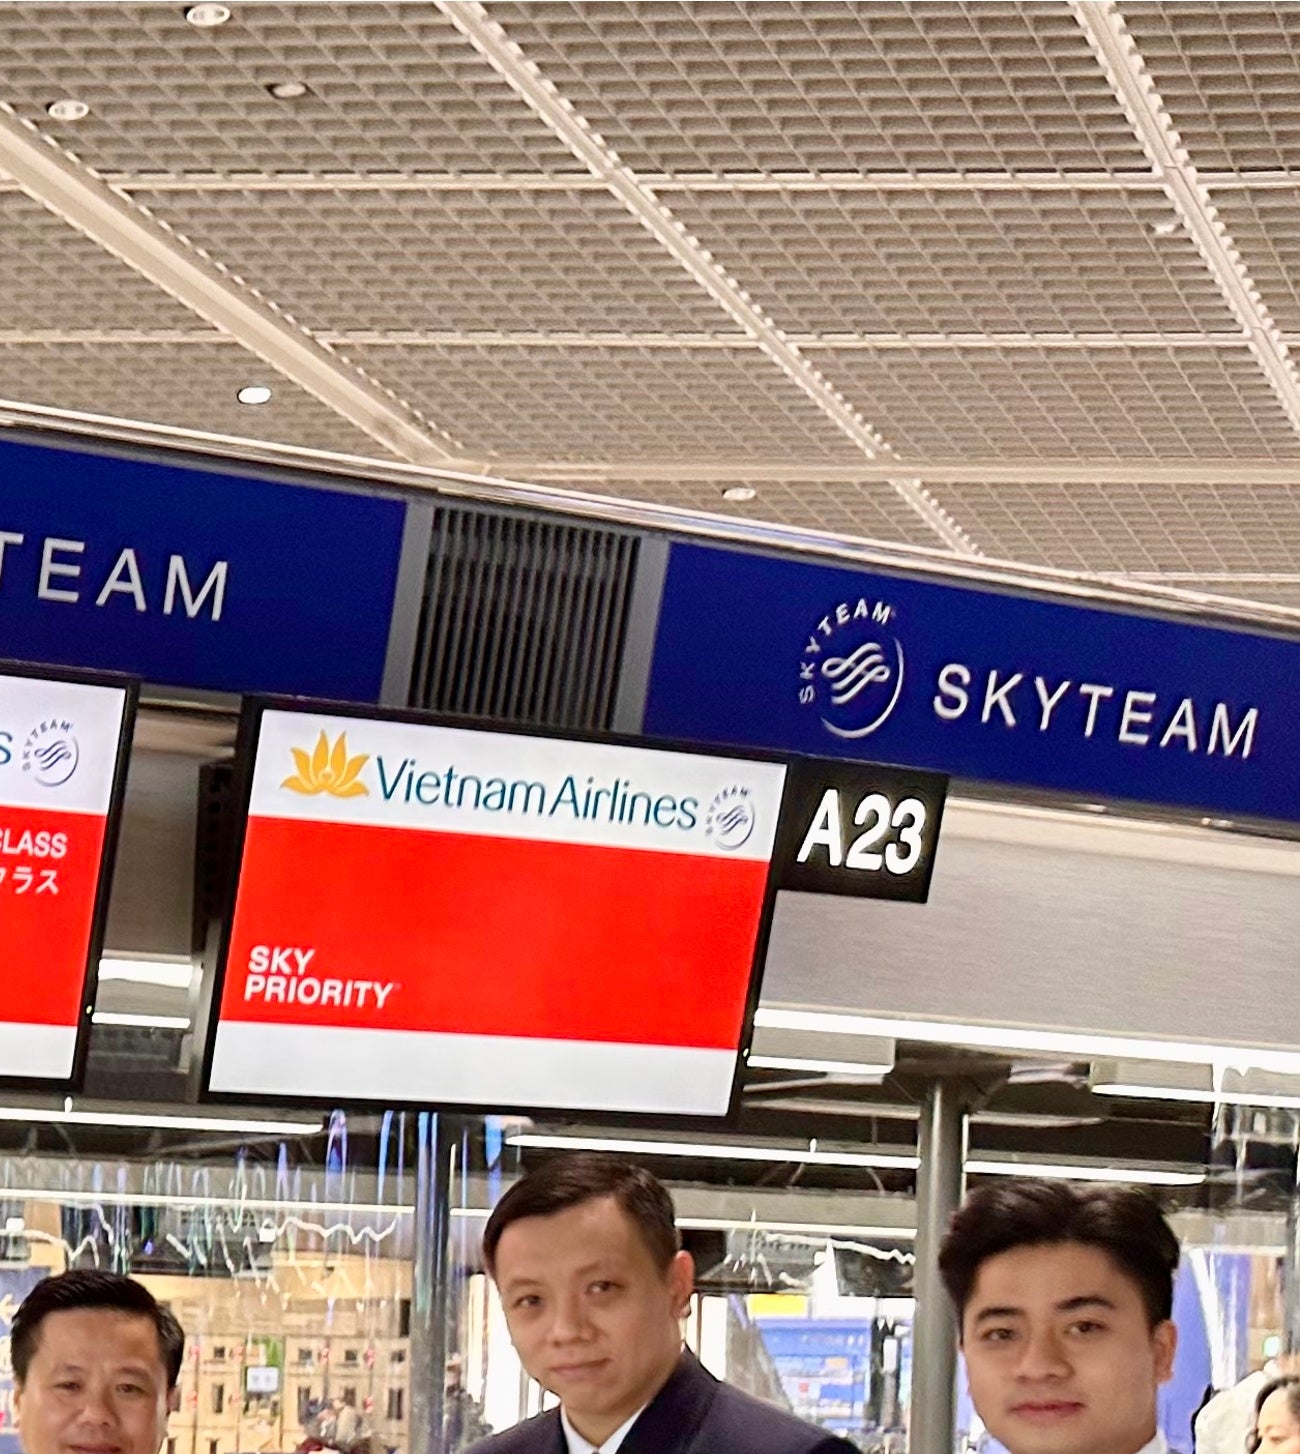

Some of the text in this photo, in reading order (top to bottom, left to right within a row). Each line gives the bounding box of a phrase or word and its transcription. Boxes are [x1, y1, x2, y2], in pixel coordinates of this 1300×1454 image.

[799, 597, 893, 704] SKYTEAM
[933, 663, 1260, 759] SKYTEAM
[796, 788, 927, 875] A23
[244, 976, 394, 1010] PRIORITY
[249, 945, 315, 976] SKY
